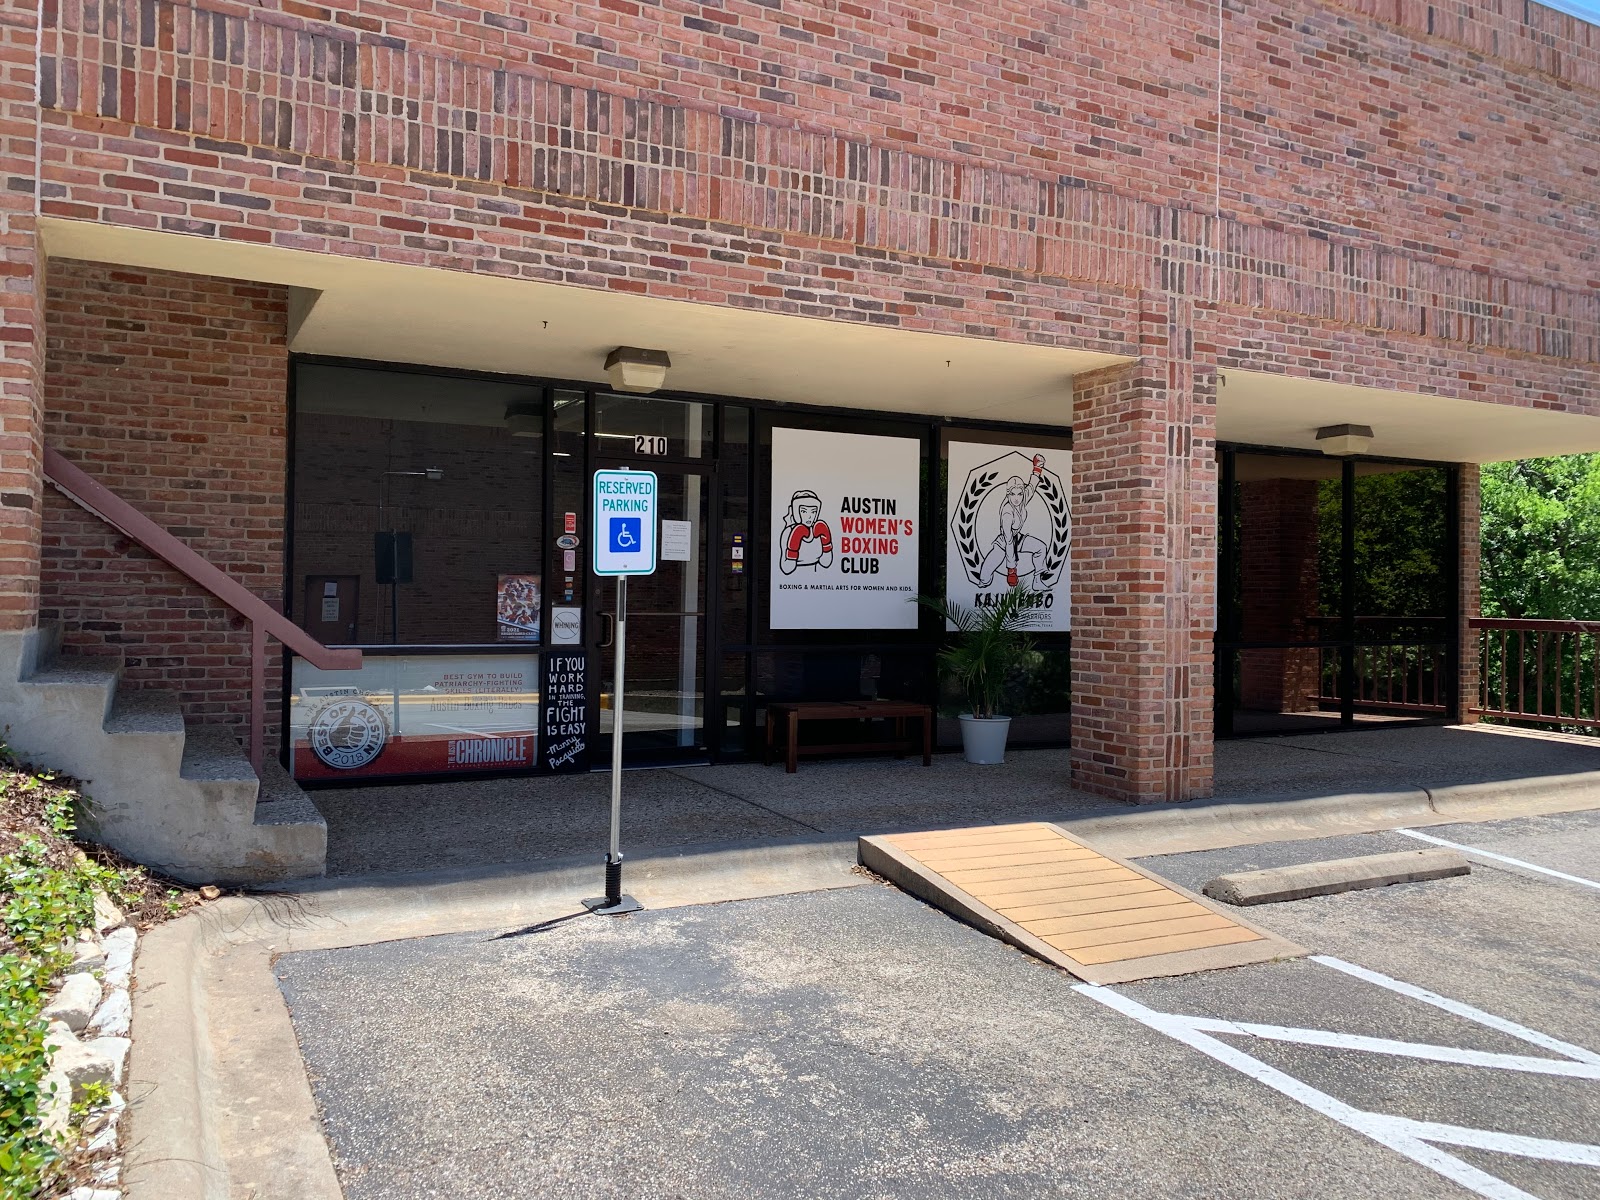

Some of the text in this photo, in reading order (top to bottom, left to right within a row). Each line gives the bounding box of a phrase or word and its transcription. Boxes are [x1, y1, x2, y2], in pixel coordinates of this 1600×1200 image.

[636, 436, 666, 455] 210
[599, 481, 651, 494] RESERVED
[602, 499, 648, 512] PARKING
[841, 497, 896, 515] AUSTIN
[840, 517, 913, 536] WOMEN'S
[841, 537, 899, 555] BOXING
[841, 557, 879, 574] CLUB
[550, 657, 585, 672] IF YOU
[549, 672, 584, 683] WORK
[475, 686, 523, 694] (LITERALLY)
[548, 684, 583, 694] HARD
[547, 706, 585, 723] FIGHT
[317, 705, 381, 757] BEST OF AUSTIN
[547, 722, 586, 736] IS EASY
[332, 752, 364, 765] 2018
[456, 737, 527, 764] CHRONICLE
